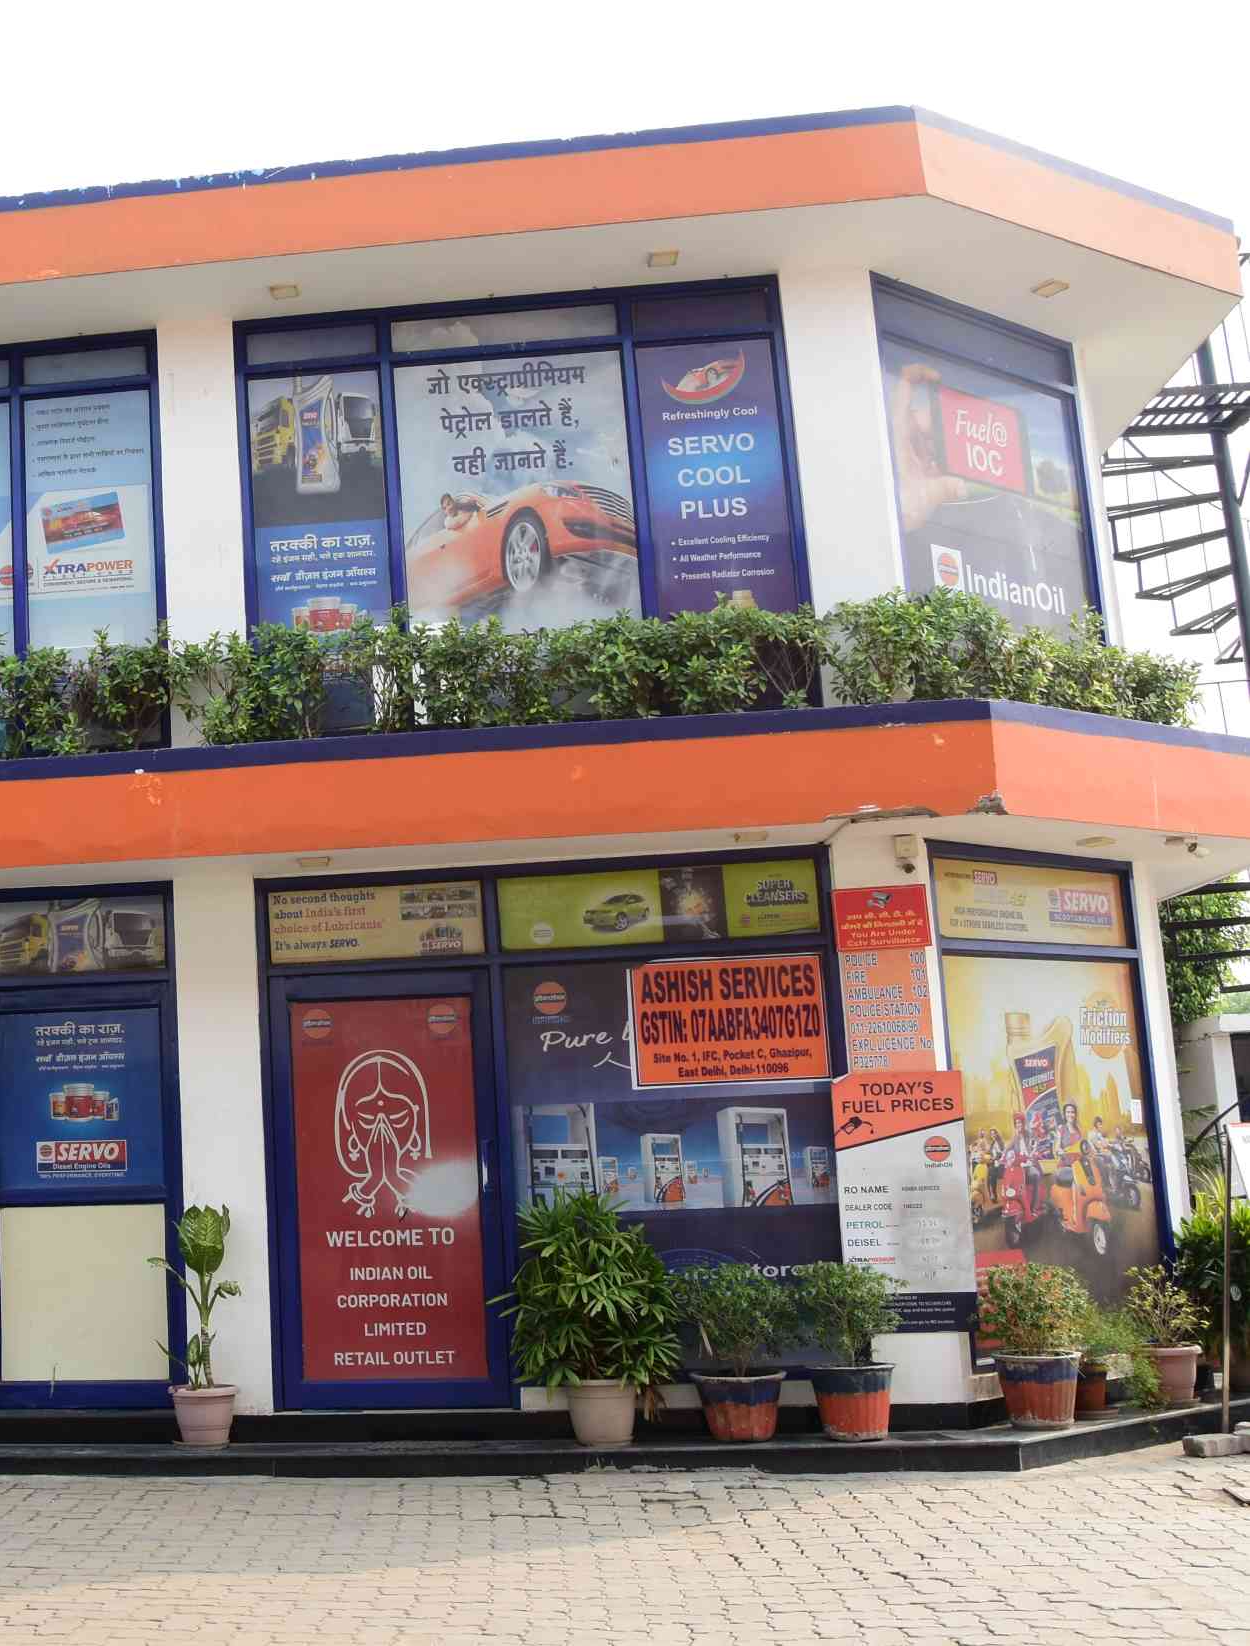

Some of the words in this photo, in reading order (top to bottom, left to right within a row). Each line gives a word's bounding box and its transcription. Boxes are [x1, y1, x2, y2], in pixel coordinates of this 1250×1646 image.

[427, 368, 450, 394] जो
[440, 406, 492, 439] पेट्रोल
[498, 400, 552, 430] डालते
[662, 407, 730, 421] Refreshingly
[732, 405, 758, 417] Cool
[954, 409, 1008, 448] Fuel@
[667, 432, 755, 456] SERVO
[452, 446, 487, 476] वही
[494, 442, 546, 471] जानते
[965, 441, 1005, 477] IOC
[677, 465, 751, 488] COOL
[680, 497, 749, 520] PLUS
[270, 533, 318, 552] तरक्की
[321, 536, 341, 548] का
[710, 535, 736, 545] Cooling
[690, 553, 717, 561] Weather
[719, 551, 762, 560] Performance
[43, 557, 134, 576] XTRAPOWER
[965, 563, 1067, 616] IndianOil
[1064, 890, 1109, 913] SERVO
[845, 954, 878, 967] POLICE
[641, 968, 713, 1005] ASHISH
[719, 963, 815, 1000] SERVICES
[846, 970, 866, 983] FIRE
[846, 986, 903, 999] AMBULANCE
[883, 1002, 921, 1016] STATION
[1078, 1006, 1127, 1027] Friction
[77, 1024, 95, 1035] का
[639, 1009, 688, 1046] GSTIN:
[1078, 1027, 1132, 1046] Modifiers
[540, 1031, 613, 1053] Pure
[653, 1052, 671, 1063] Site
[673, 1051, 690, 1063] No.
[702, 1050, 722, 1063] IFC,
[723, 1049, 755, 1061] Pocket
[769, 1047, 812, 1059] Ghazipur,
[678, 1066, 699, 1078] East
[701, 1065, 728, 1078] Delhi,
[859, 1081, 934, 1097] TODAY'S
[841, 1100, 886, 1114] FUEL
[891, 1097, 955, 1113] PRICES
[57, 1142, 120, 1161] SERVO
[843, 1186, 858, 1194] RO
[860, 1185, 890, 1193] NAME
[846, 1221, 885, 1229] PETROL
[326, 1228, 423, 1247] WELCOME
[428, 1227, 455, 1246] TO
[847, 1238, 882, 1247] DEISEL
[349, 1266, 404, 1281] INDIAN
[407, 1265, 433, 1280] OIL
[337, 1292, 448, 1309] CORPORATION
[364, 1321, 427, 1337] LIMITED
[333, 1351, 391, 1366] RETAIL
[393, 1349, 455, 1365] OUTLET
